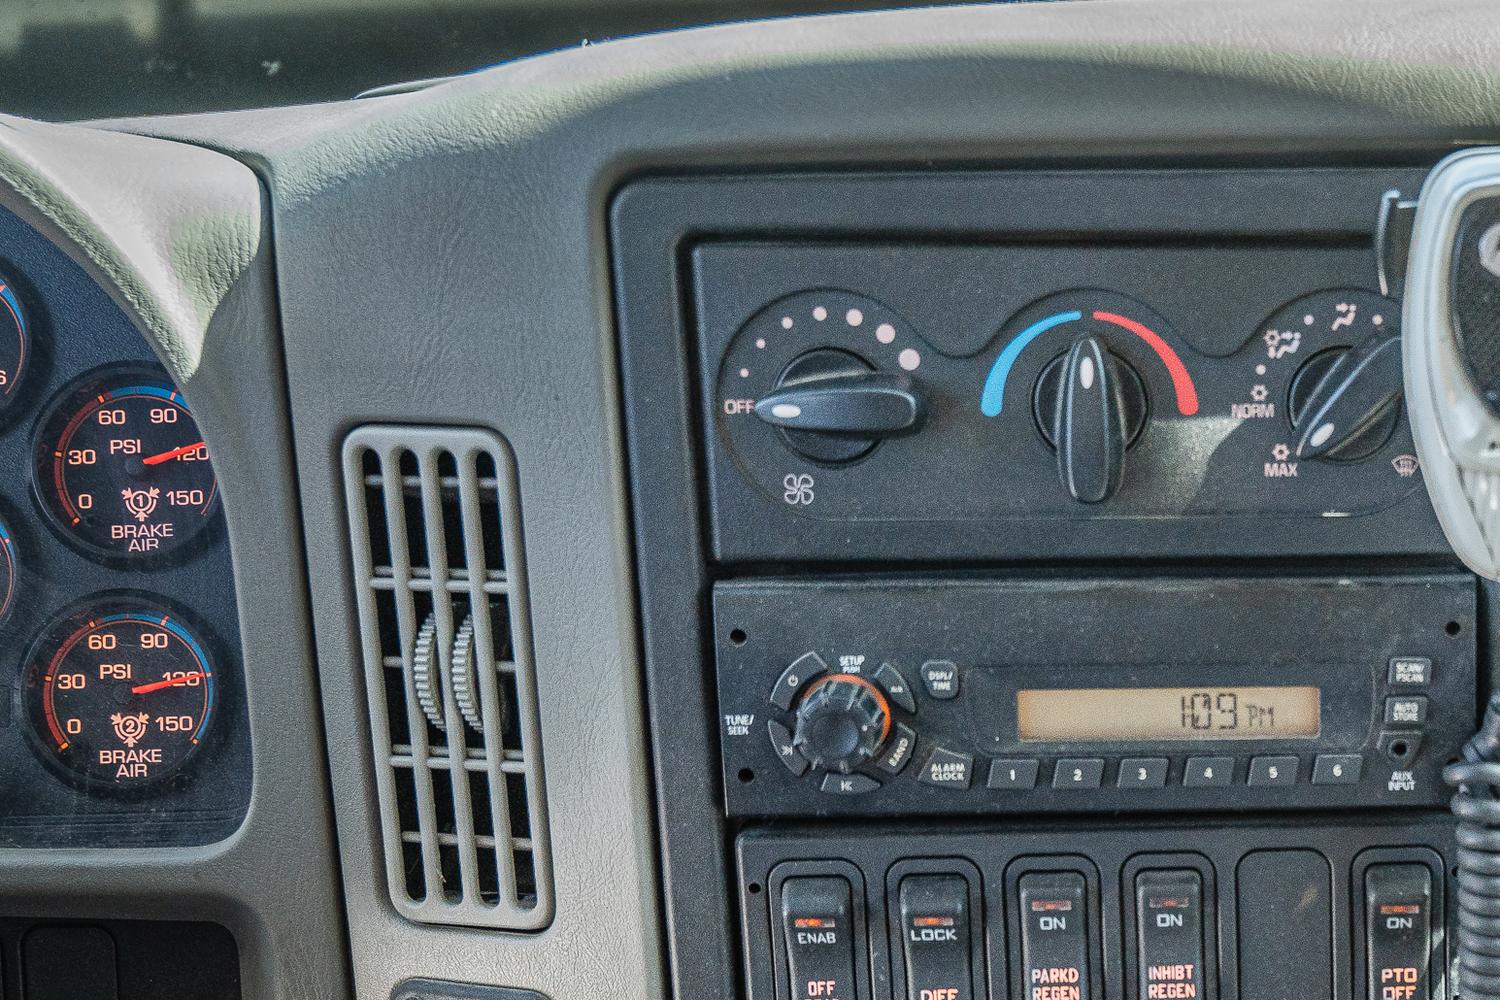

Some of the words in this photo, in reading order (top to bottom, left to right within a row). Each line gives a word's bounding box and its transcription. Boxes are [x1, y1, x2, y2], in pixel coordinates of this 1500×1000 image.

[724, 399, 755, 415] OFF
[1231, 403, 1275, 419] NORM
[98, 410, 126, 426] 60
[150, 408, 177, 424] 90
[110, 439, 142, 455] PSI
[174, 445, 209, 462] 120
[68, 449, 96, 465] 30
[1264, 462, 1298, 477] MAX
[78, 494, 93, 509] 0
[166, 490, 204, 505] 150
[111, 523, 174, 539] BRAKE
[128, 538, 159, 552] AIR
[88, 635, 117, 650] 60
[141, 634, 168, 648] 90
[839, 655, 865, 667] SETUP
[99, 664, 132, 680] PSI
[162, 671, 200, 687] 120
[58, 674, 86, 690] 30
[725, 714, 754, 726] TUNE/
[1246, 704, 1275, 727] PM
[67, 719, 81, 735] 0
[155, 716, 193, 732] 150
[728, 725, 749, 735] SEEK
[100, 749, 162, 765] BRAKE
[889, 737, 909, 767] BAND
[116, 764, 148, 778] AIR
[931, 763, 966, 773] ALARM
[1009, 769, 1016, 780] 1
[1073, 769, 1083, 781] 2
[1138, 768, 1147, 780] 3
[1203, 767, 1214, 779] 4
[1269, 766, 1278, 779] 5
[1332, 764, 1342, 777] 6
[1391, 770, 1414, 781] AUX
[932, 772, 965, 781] CLOCK
[1387, 780, 1416, 791] INPUT
[1039, 915, 1067, 930] ON
[1156, 912, 1183, 928] ON
[1385, 915, 1413, 930] ON
[797, 931, 837, 944] ENAB
[910, 927, 958, 942] LOCK
[1031, 967, 1079, 985] PARKD
[1147, 963, 1194, 981] INHIBT
[1381, 967, 1418, 984] PTO
[807, 980, 835, 997] OFF
[1148, 981, 1196, 1000] REGEN
